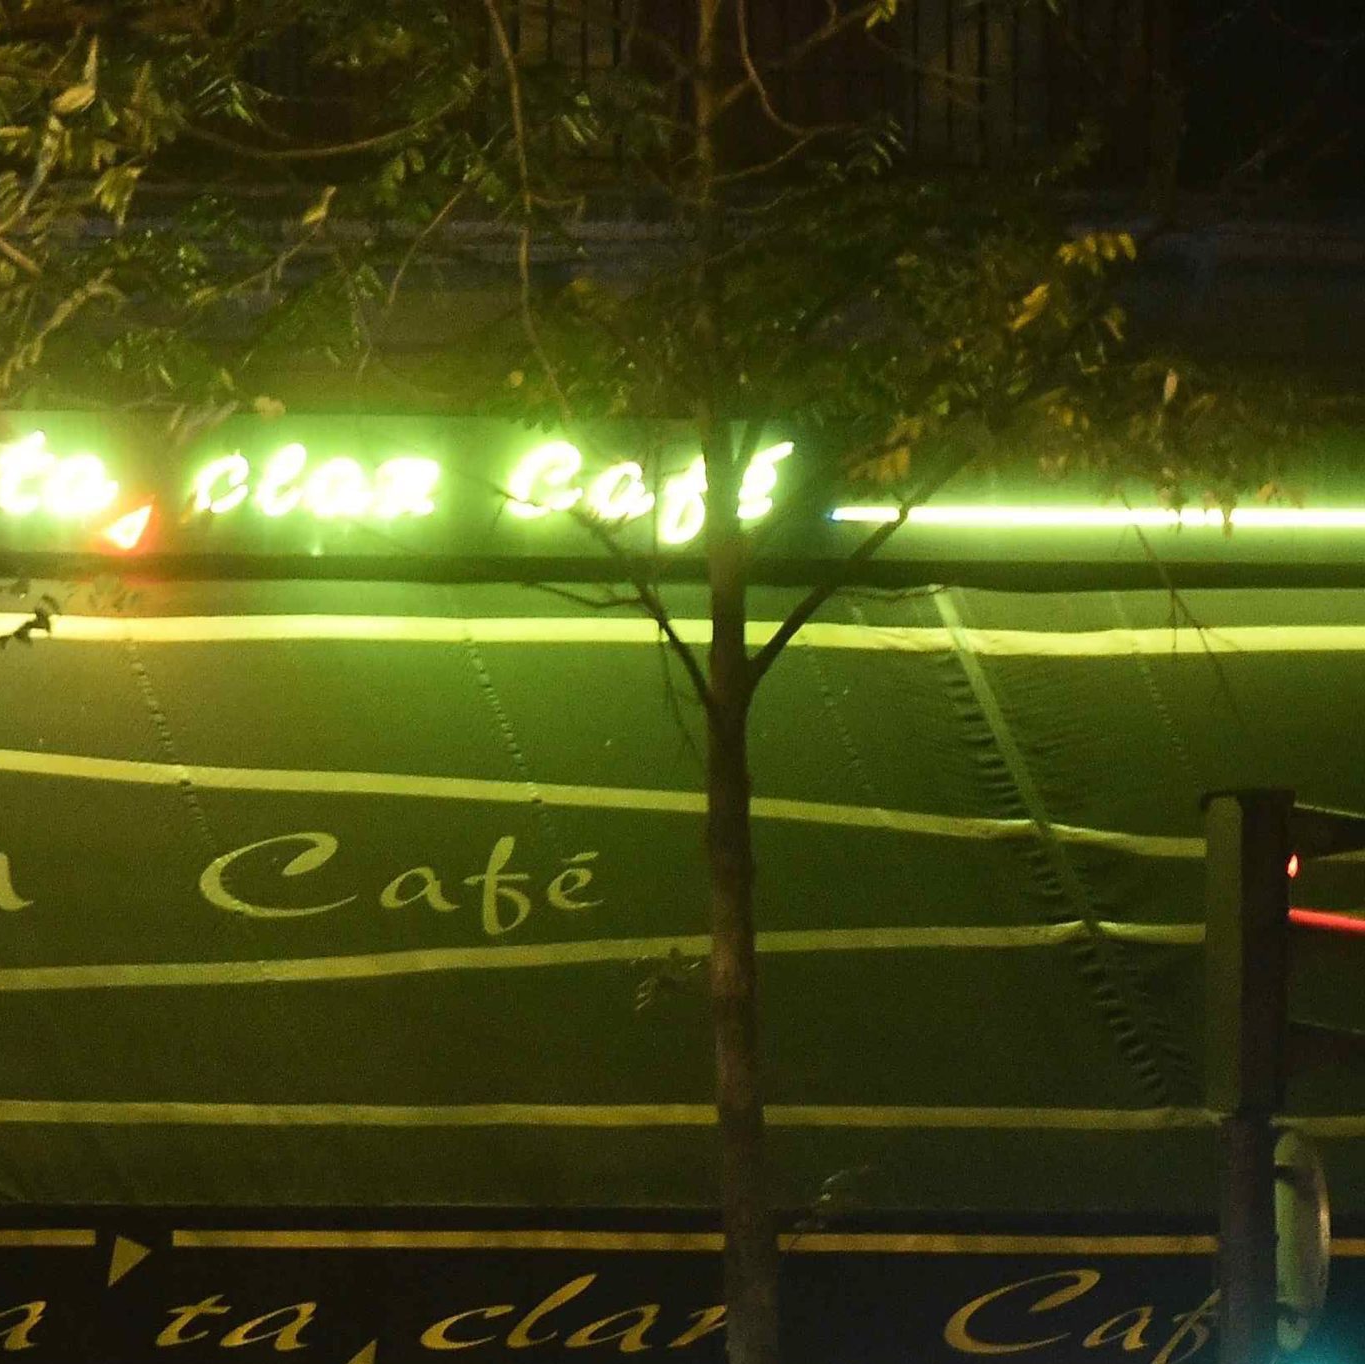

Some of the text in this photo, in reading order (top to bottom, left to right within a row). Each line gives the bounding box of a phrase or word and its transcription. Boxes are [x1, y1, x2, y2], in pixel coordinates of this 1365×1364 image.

[193, 443, 440, 517] clan
[504, 439, 795, 545] Café
[198, 832, 604, 936] Café
